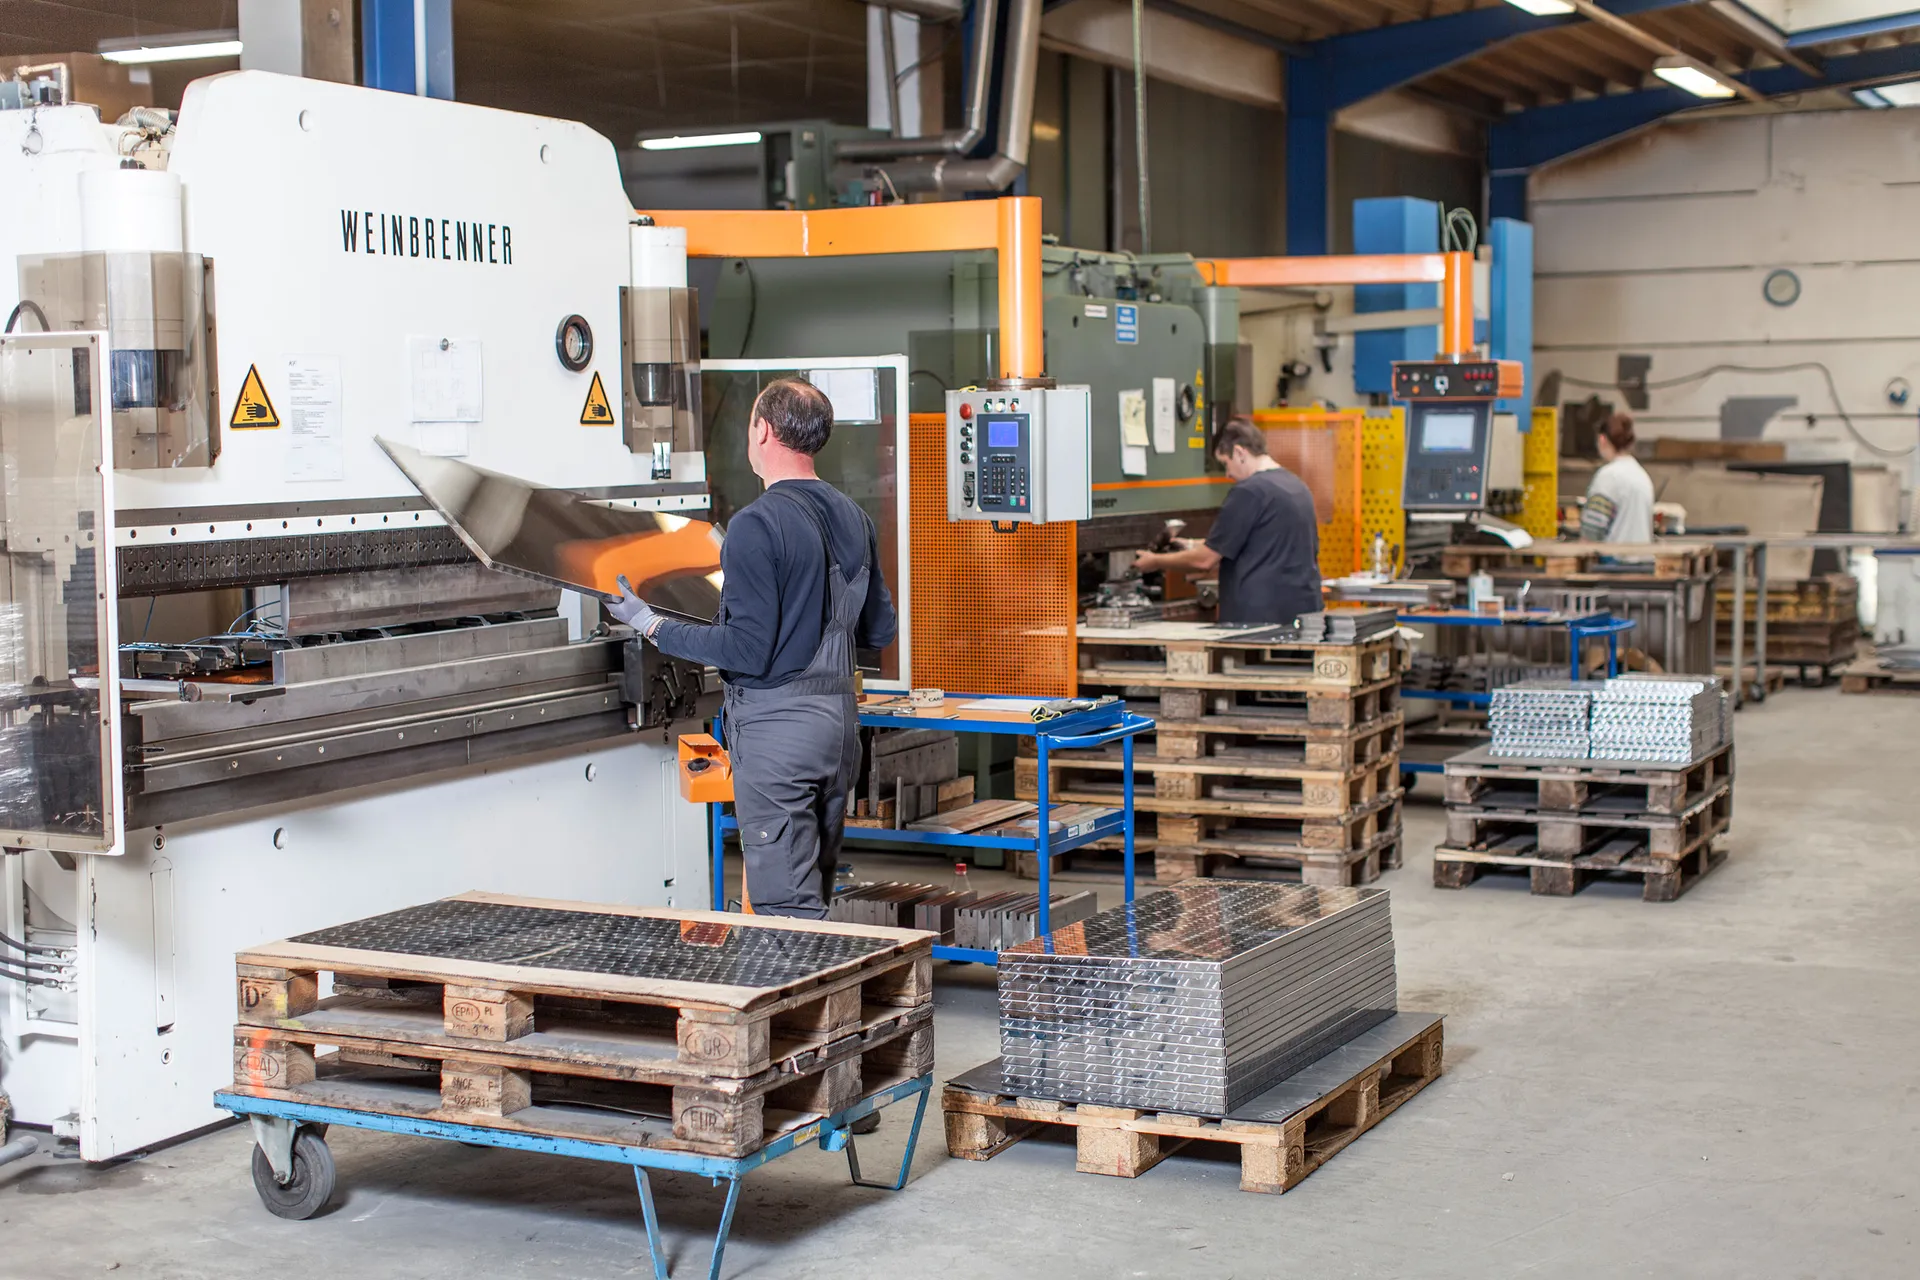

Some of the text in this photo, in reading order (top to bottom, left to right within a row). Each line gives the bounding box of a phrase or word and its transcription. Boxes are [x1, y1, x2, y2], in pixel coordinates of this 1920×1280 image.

[341, 209, 512, 264] WEINBRENNER
[484, 1006, 494, 1016] PL
[690, 1110, 718, 1132] EUR
